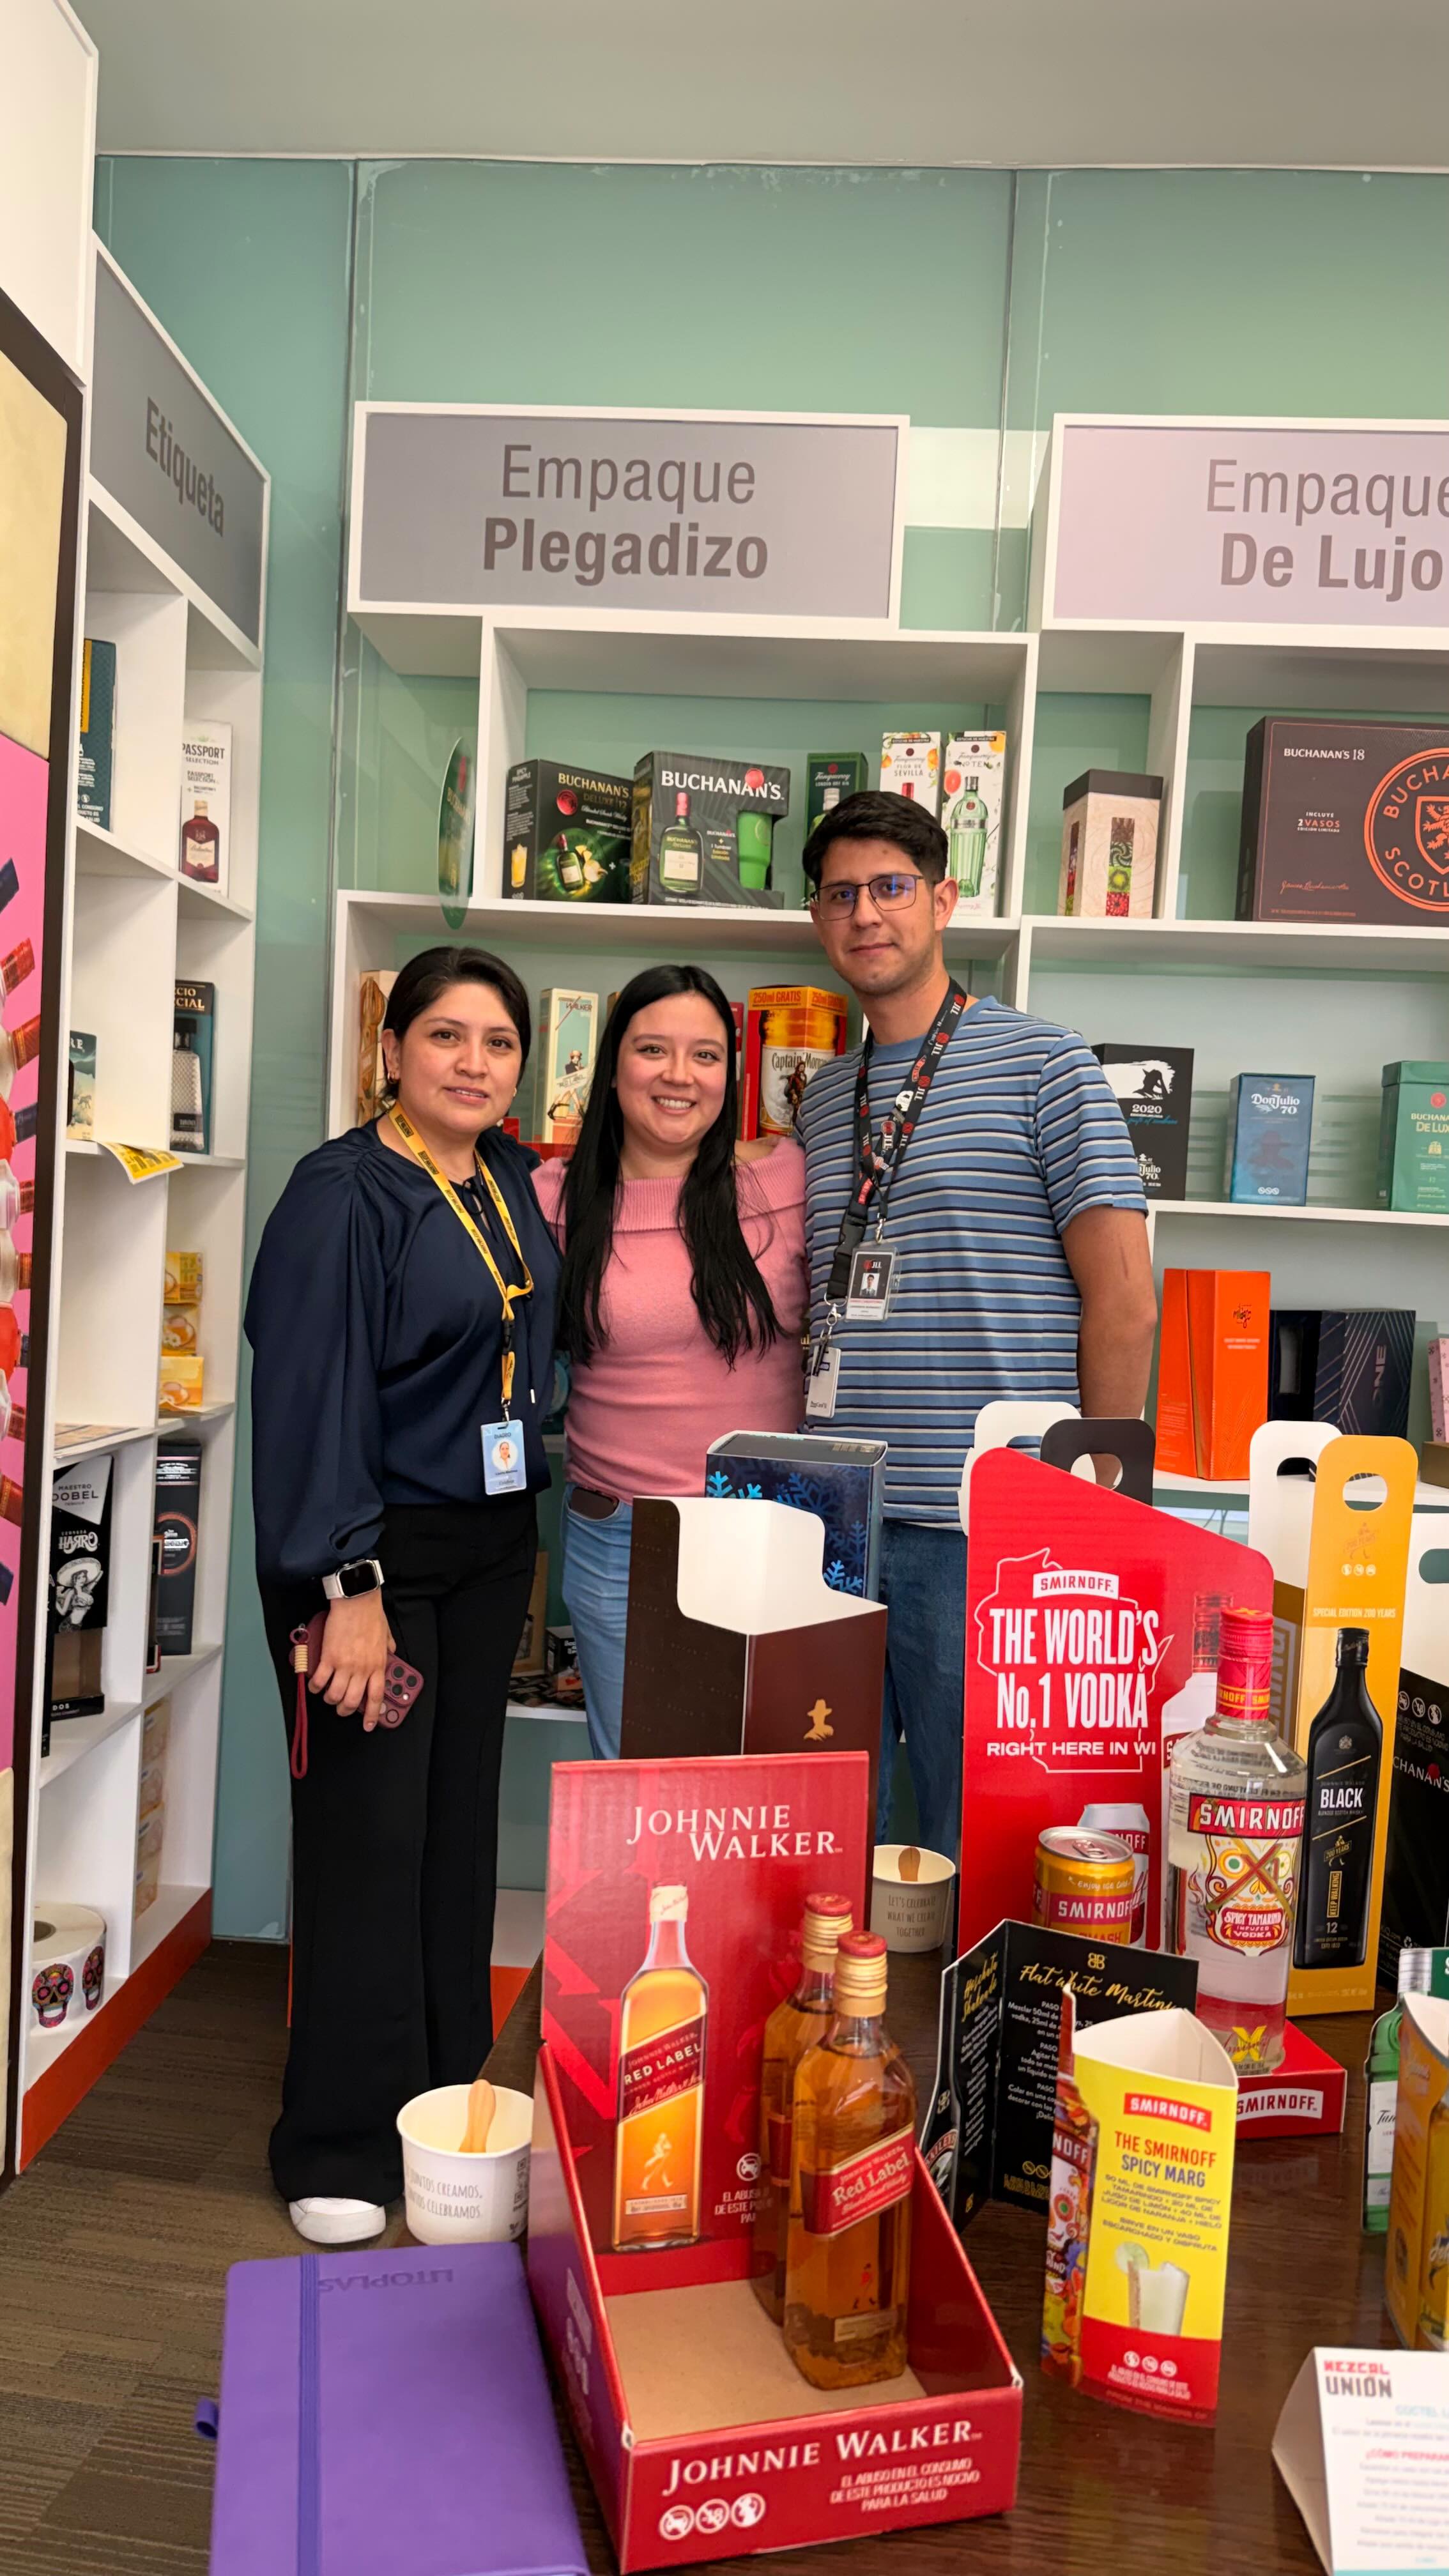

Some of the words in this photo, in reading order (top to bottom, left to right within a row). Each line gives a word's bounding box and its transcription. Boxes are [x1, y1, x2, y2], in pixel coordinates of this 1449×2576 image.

[146, 397, 224, 537] Etiqueta
[503, 445, 755, 514] Empaque
[484, 518, 767, 586] Plegadizo
[1221, 533, 1293, 587] De
[1318, 535, 1443, 602] Lujo
[1284, 748, 1349, 759] BUCHANAN'S
[1353, 749, 1365, 760] 18
[558, 772, 629, 799] BUCHANAN'S
[1305, 820, 1340, 828] VASOS
[776, 990, 801, 1002] GRATIS
[950, 1002, 961, 1015] JLL
[931, 1042, 944, 1055] JLL
[772, 1052, 800, 1070] Captain
[914, 1086, 926, 1101] JLL
[1132, 1104, 1162, 1114] 2020
[1280, 1106, 1297, 1114] 70
[871, 1261, 882, 1269] JLL
[1040, 1575, 1112, 1591] SMIRNOFF
[1313, 1607, 1337, 1618] SPECIAL
[1338, 1608, 1363, 1618] EDITION
[1364, 1609, 1376, 1619] 200
[1377, 1609, 1396, 1619] YEARS
[990, 1608, 1038, 1664] THE
[1044, 1608, 1160, 1666] WORLD'S
[1064, 1672, 1149, 1728] VODKA
[986, 1742, 1048, 1756] RIGHT
[1052, 1742, 1104, 1756] HERE
[1110, 1742, 1131, 1756] IN
[1135, 1742, 1156, 1755] WI
[1320, 1788, 1363, 1809] BLACK
[1200, 1801, 1305, 1831] SMIRNOFF
[626, 1804, 791, 1845] JOHNNIE
[689, 1831, 835, 1861] WALKER
[1331, 1872, 1340, 1899] WALKING
[889, 1894, 905, 1908] LET'S
[907, 1896, 936, 1909] CELEBRATE
[1328, 1900, 1337, 1916] KEEP
[888, 1912, 905, 1922] WHAT
[906, 1912, 916, 1923] WE
[1225, 1910, 1246, 1924] SPICY
[1247, 1911, 1282, 1926] TAMARIND
[896, 1926, 925, 1938] TOGETHER
[1233, 1930, 1271, 1938] VODKA
[1326, 1922, 1338, 1934] 12
[1020, 1963, 1063, 1985] Flat
[1032, 2007, 1050, 2018] 50ml
[1050, 2012, 1059, 2020] de
[1041, 2001, 1059, 2011] PASO
[1032, 2017, 1048, 2028] 25ml
[1039, 2042, 1057, 2053] PASO
[624, 2065, 653, 2085] RED
[656, 2043, 701, 2070] LABEL
[1021, 2057, 1036, 2066] todo
[1037, 2082, 1054, 2094] PASO
[1031, 2099, 1043, 2109] con
[1034, 2092, 1046, 2101] una
[1237, 2092, 1315, 2115] SMIRNOFF
[1130, 2097, 1205, 2126] SMIRNOFF
[1115, 2130, 1140, 2153] THE
[1144, 2139, 1217, 2168] SMIRNOFF
[832, 2177, 866, 2205] Red
[867, 2152, 910, 2186] Label
[1121, 2154, 1161, 2179] SPICY
[1165, 2165, 1206, 2188] MARG
[1324, 2359, 1390, 2375] MEZCAL
[662, 2442, 821, 2497] JOHNNIE
[836, 2420, 972, 2460] WALKER
[841, 2474, 853, 2488] EL
[855, 2467, 890, 2485] ABUSO
[891, 2467, 906, 2480] EN
[907, 2465, 918, 2478] EL
[921, 2457, 972, 2476] CONSUMO
[831, 2490, 844, 2504] DE
[847, 2485, 871, 2501] ESTE
[873, 2476, 927, 2497] PRODUCTO
[928, 2474, 942, 2488] ES
[943, 2469, 981, 2486] NOCIVO
[861, 2495, 892, 2512] PARA
[894, 2494, 909, 2507] LA
[910, 2487, 948, 2505] SALUD
